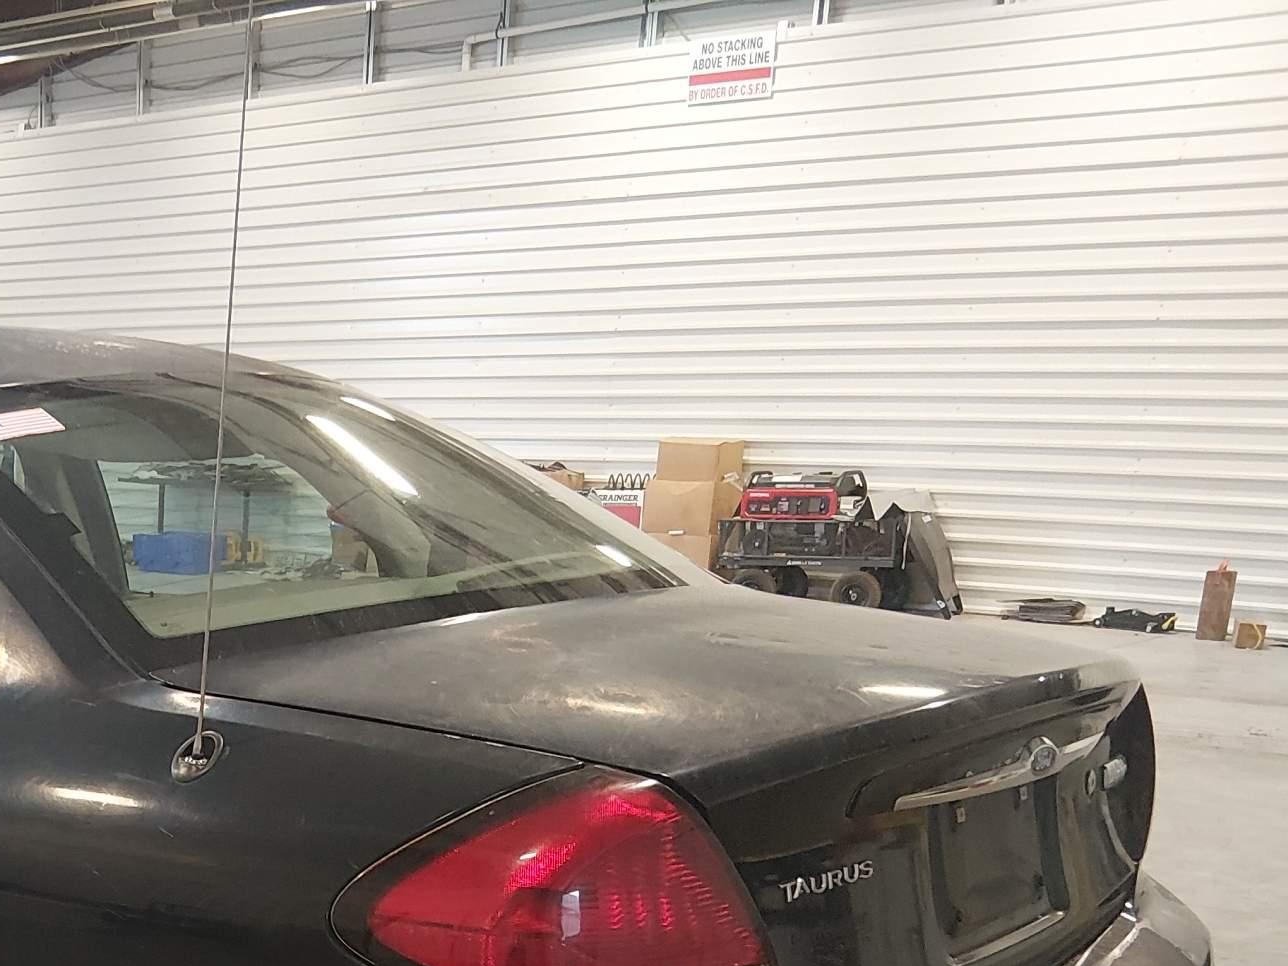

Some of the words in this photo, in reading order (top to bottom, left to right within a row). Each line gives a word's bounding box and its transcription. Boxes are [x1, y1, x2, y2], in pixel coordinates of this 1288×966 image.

[702, 42, 715, 55] NO
[717, 36, 764, 53] STACKING
[692, 56, 723, 71] ABOVE
[726, 53, 746, 67] THIS
[749, 50, 770, 65] LINE
[688, 89, 698, 102] BY
[700, 86, 726, 100] ORDER
[728, 84, 739, 97] OF
[778, 860, 874, 903] TAURUS
